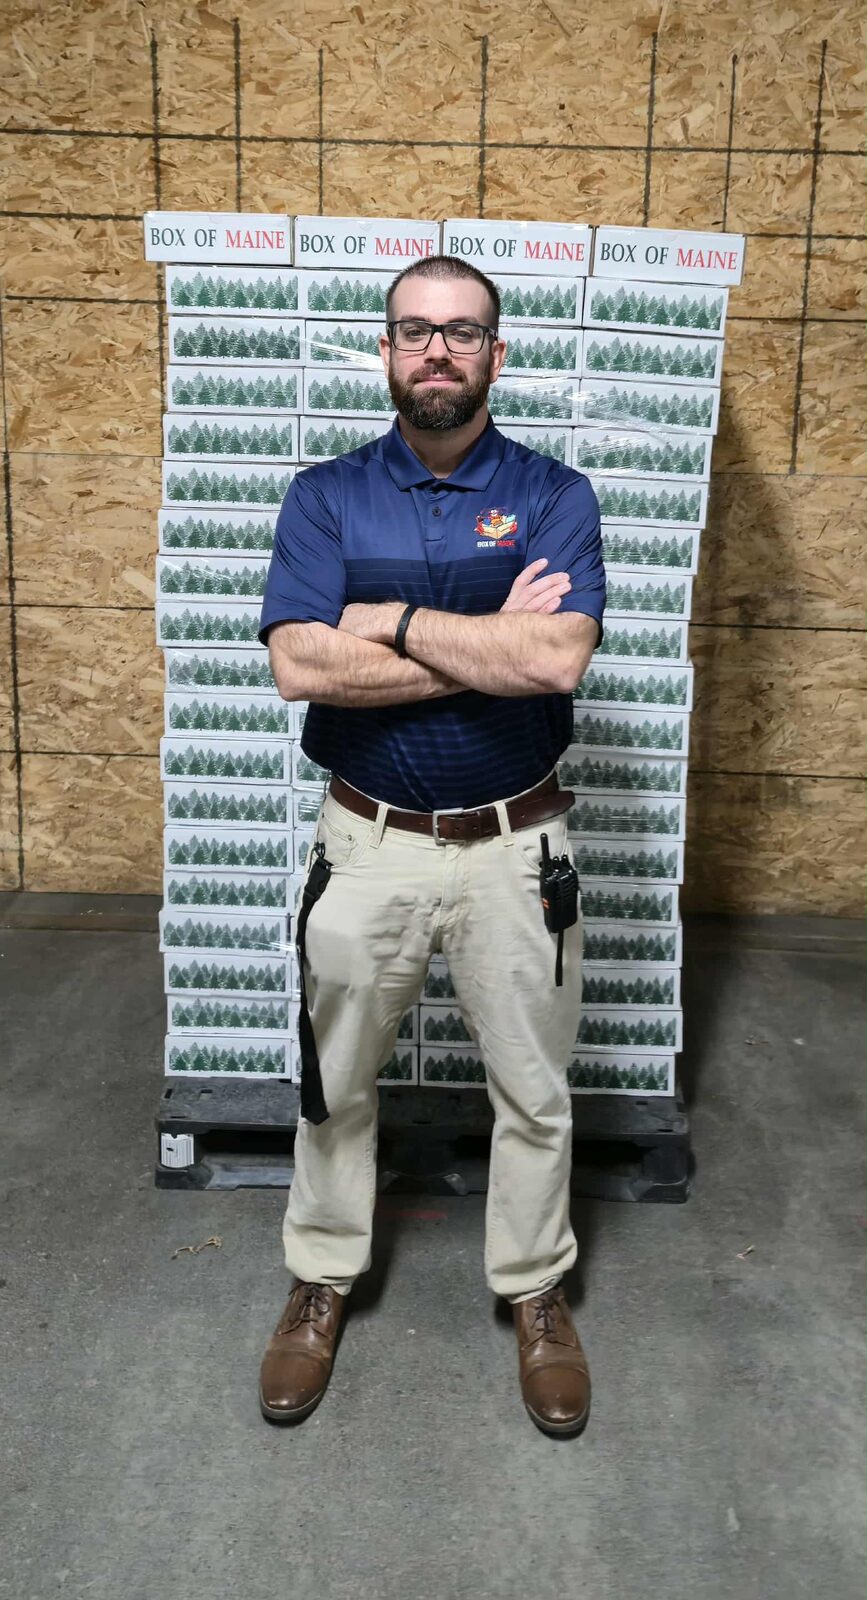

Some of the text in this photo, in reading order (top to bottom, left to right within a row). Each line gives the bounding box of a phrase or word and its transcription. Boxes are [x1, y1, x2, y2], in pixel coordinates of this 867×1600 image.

[150, 228, 285, 249] BOX OF MAINE
[300, 234, 434, 257] BOX OF MAINE
[449, 236, 585, 261] BOX OF MAINE
[600, 243, 738, 270] BOX OF MAINE
